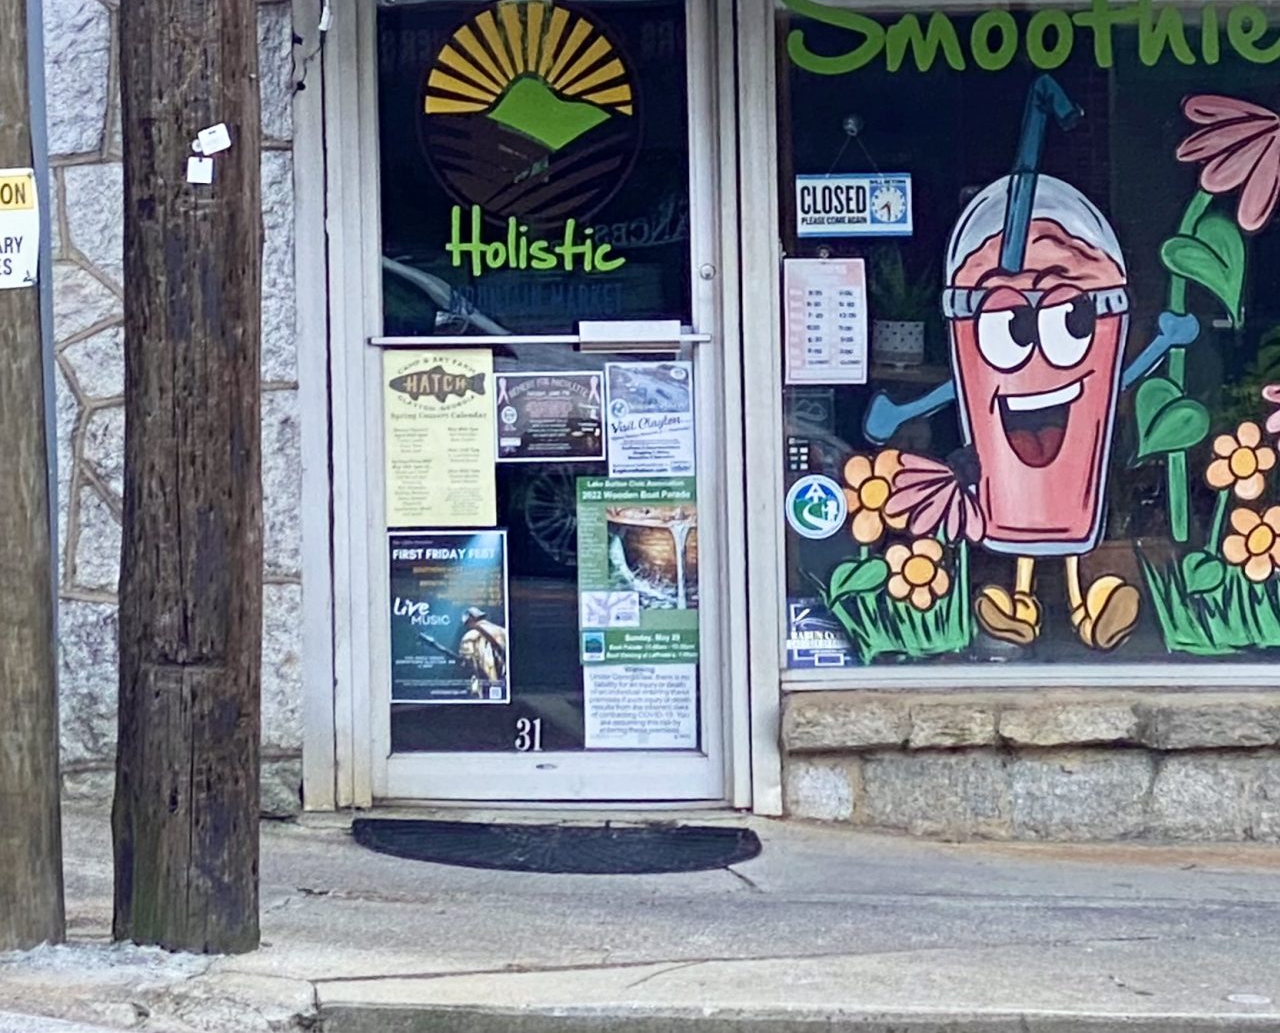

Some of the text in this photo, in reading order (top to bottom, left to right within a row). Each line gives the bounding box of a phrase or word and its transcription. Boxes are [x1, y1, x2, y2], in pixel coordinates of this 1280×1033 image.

[0, 182, 27, 205] ON
[800, 185, 867, 215] CLOSED
[801, 217, 825, 225] PLEASE
[446, 204, 627, 277] Holistic
[0, 258, 12, 275] S
[406, 374, 466, 392] HATCH
[611, 420, 637, 434] Visit
[638, 415, 681, 429] Clayton
[661, 490, 691, 498] Parade
[393, 549, 424, 560] FIRST
[426, 549, 466, 560] FRIDAY
[394, 597, 430, 616] Live
[411, 615, 450, 625] MUSIC
[515, 718, 542, 751] 31
